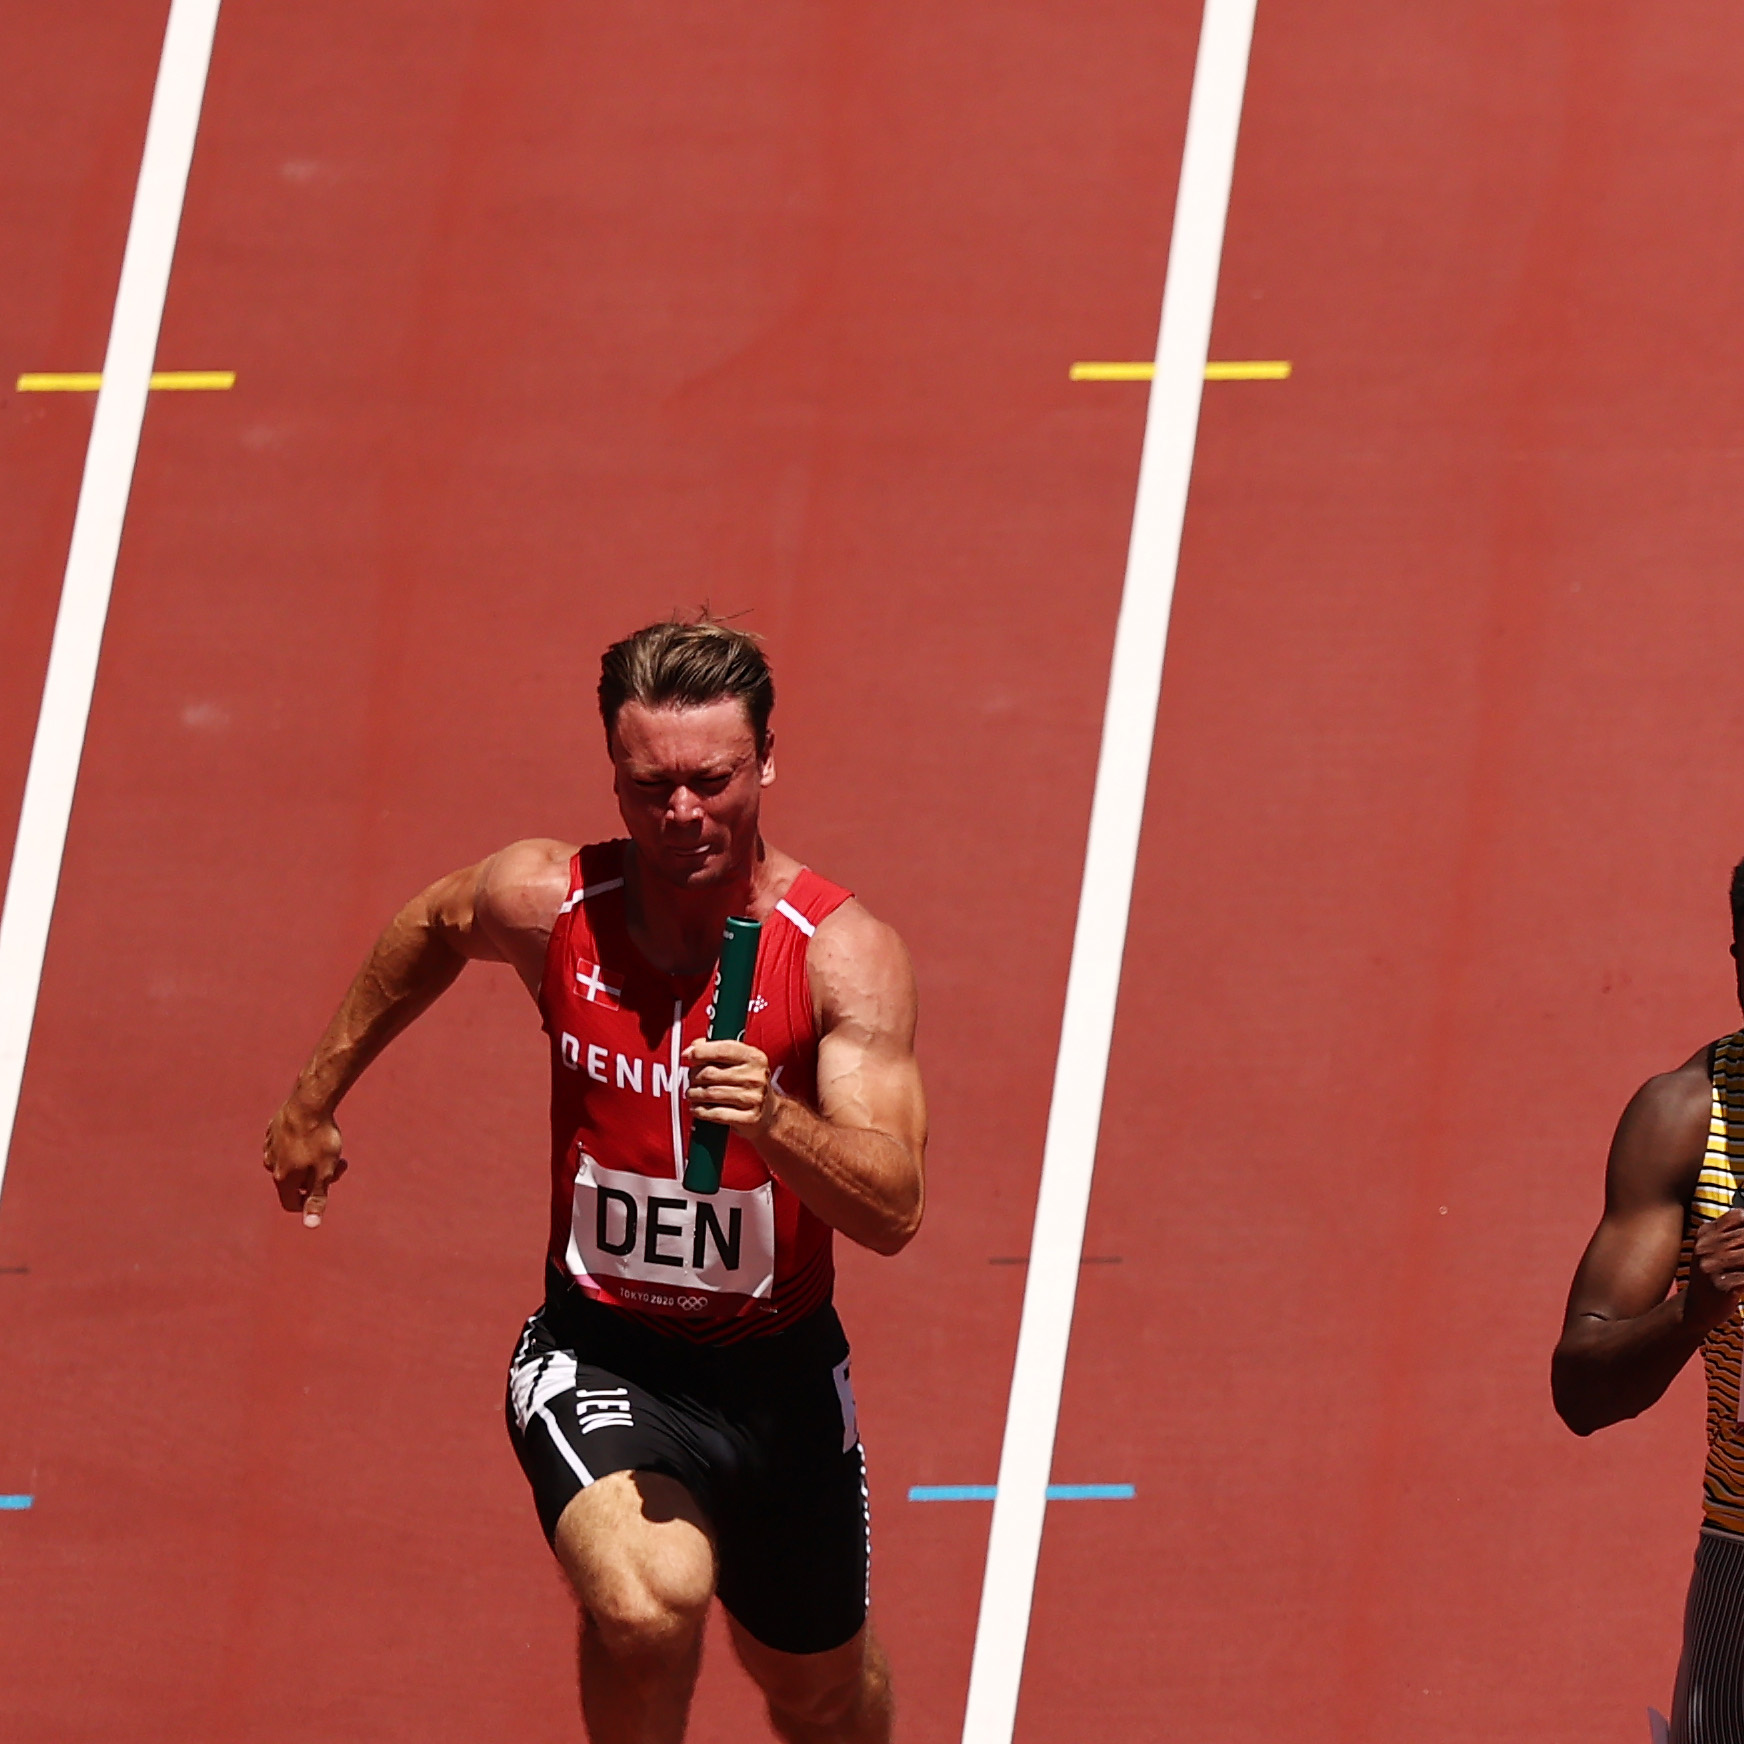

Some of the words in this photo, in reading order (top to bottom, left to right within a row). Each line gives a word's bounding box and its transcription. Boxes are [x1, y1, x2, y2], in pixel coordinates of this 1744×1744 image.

[596, 1183, 743, 1272] DEN
[620, 1287, 649, 1302] TOKYO
[650, 1295, 675, 1306] 2020
